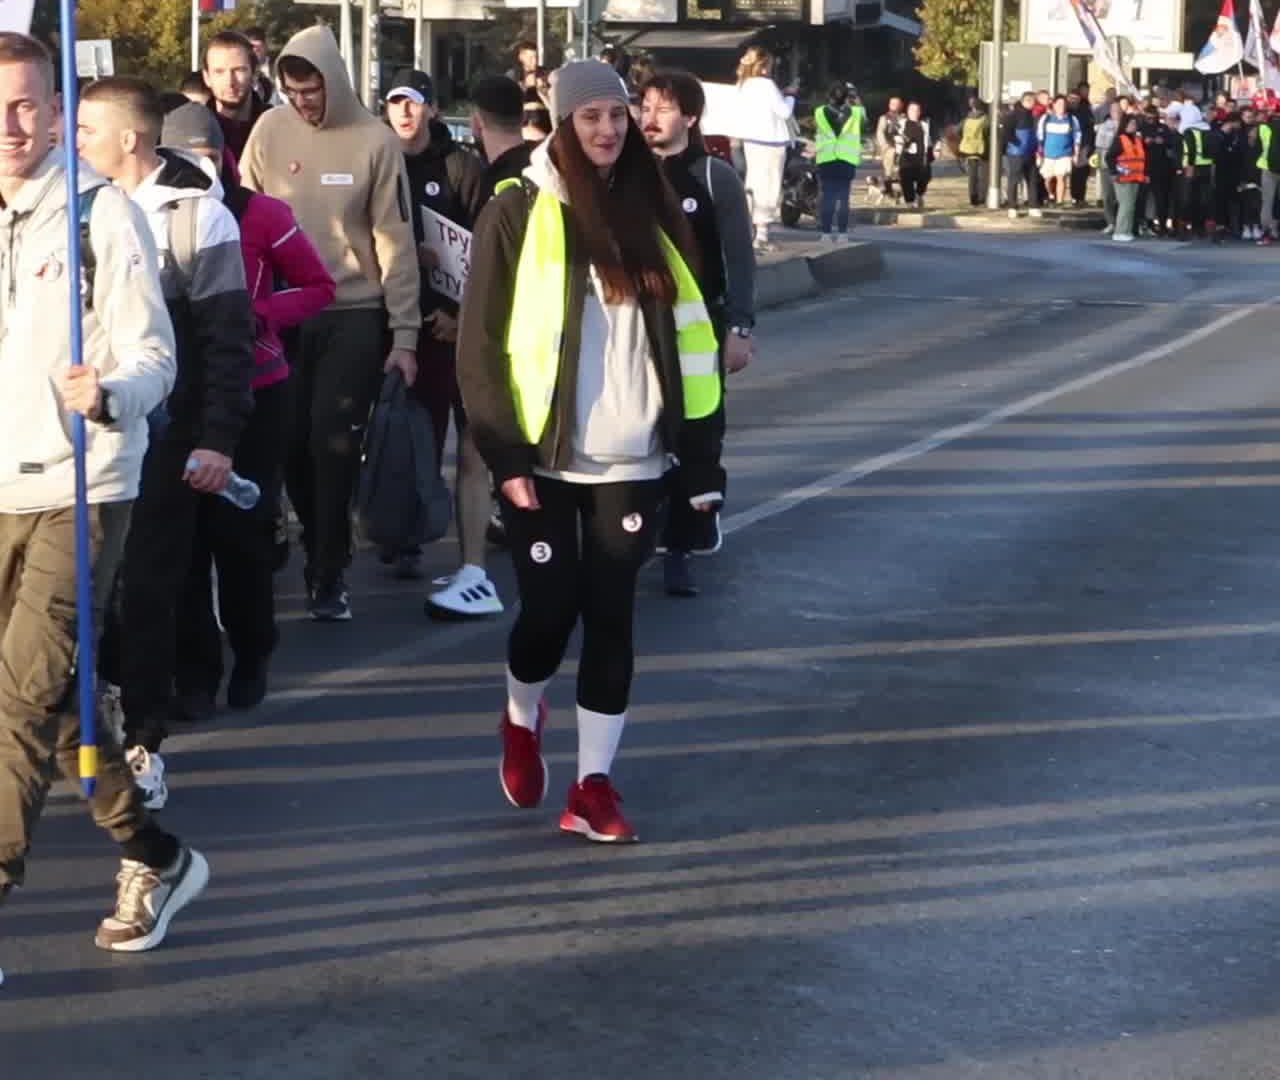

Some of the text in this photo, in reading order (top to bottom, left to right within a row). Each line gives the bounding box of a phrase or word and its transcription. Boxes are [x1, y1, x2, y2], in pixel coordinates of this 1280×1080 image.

[434, 219, 469, 254] ТРУ
[431, 267, 463, 295] СТУ
[535, 544, 547, 560] 3
